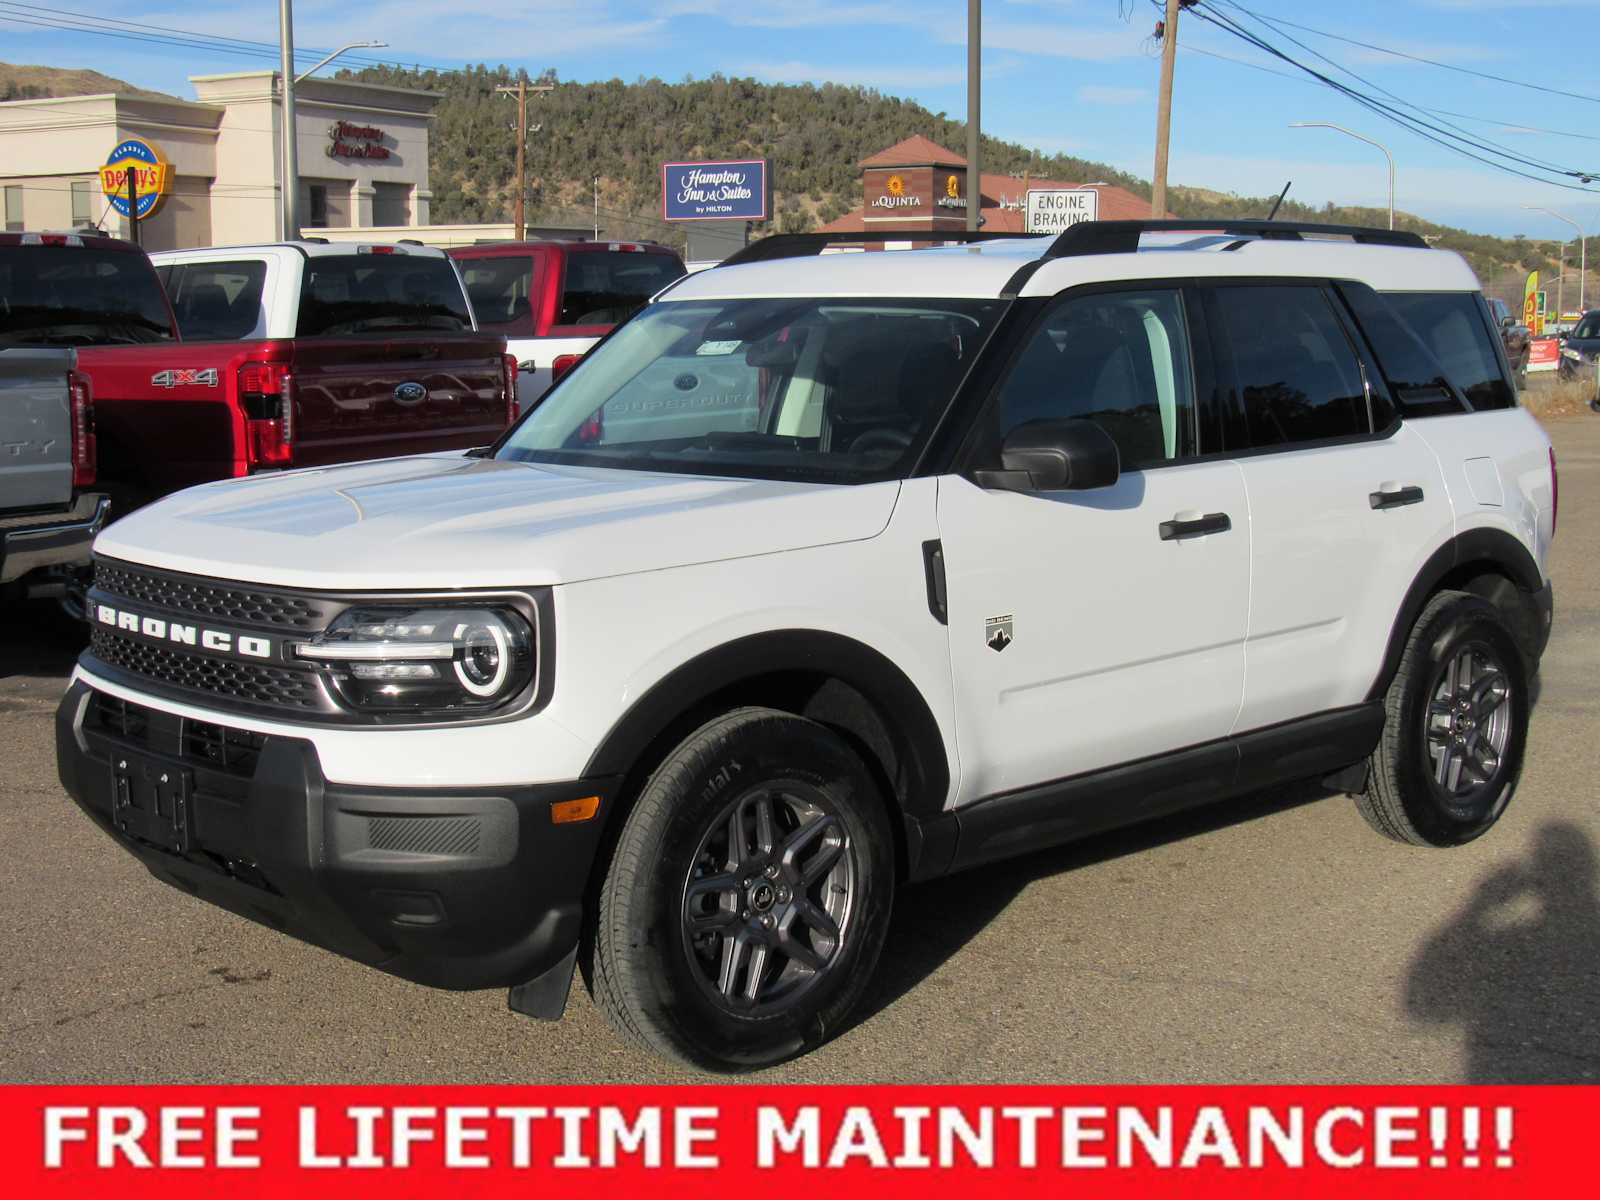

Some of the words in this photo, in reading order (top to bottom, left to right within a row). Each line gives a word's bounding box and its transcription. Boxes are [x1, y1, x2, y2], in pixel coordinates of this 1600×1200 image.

[681, 169, 746, 189] Hampton
[677, 188, 709, 203] Inn
[708, 191, 718, 202] &
[716, 185, 752, 201] Suites
[879, 195, 921, 208] QUINTA
[1038, 195, 1085, 209] ENGINE
[705, 205, 733, 213] HILTON
[1033, 212, 1089, 226] BRAKING
[97, 604, 271, 658] BRONCO
